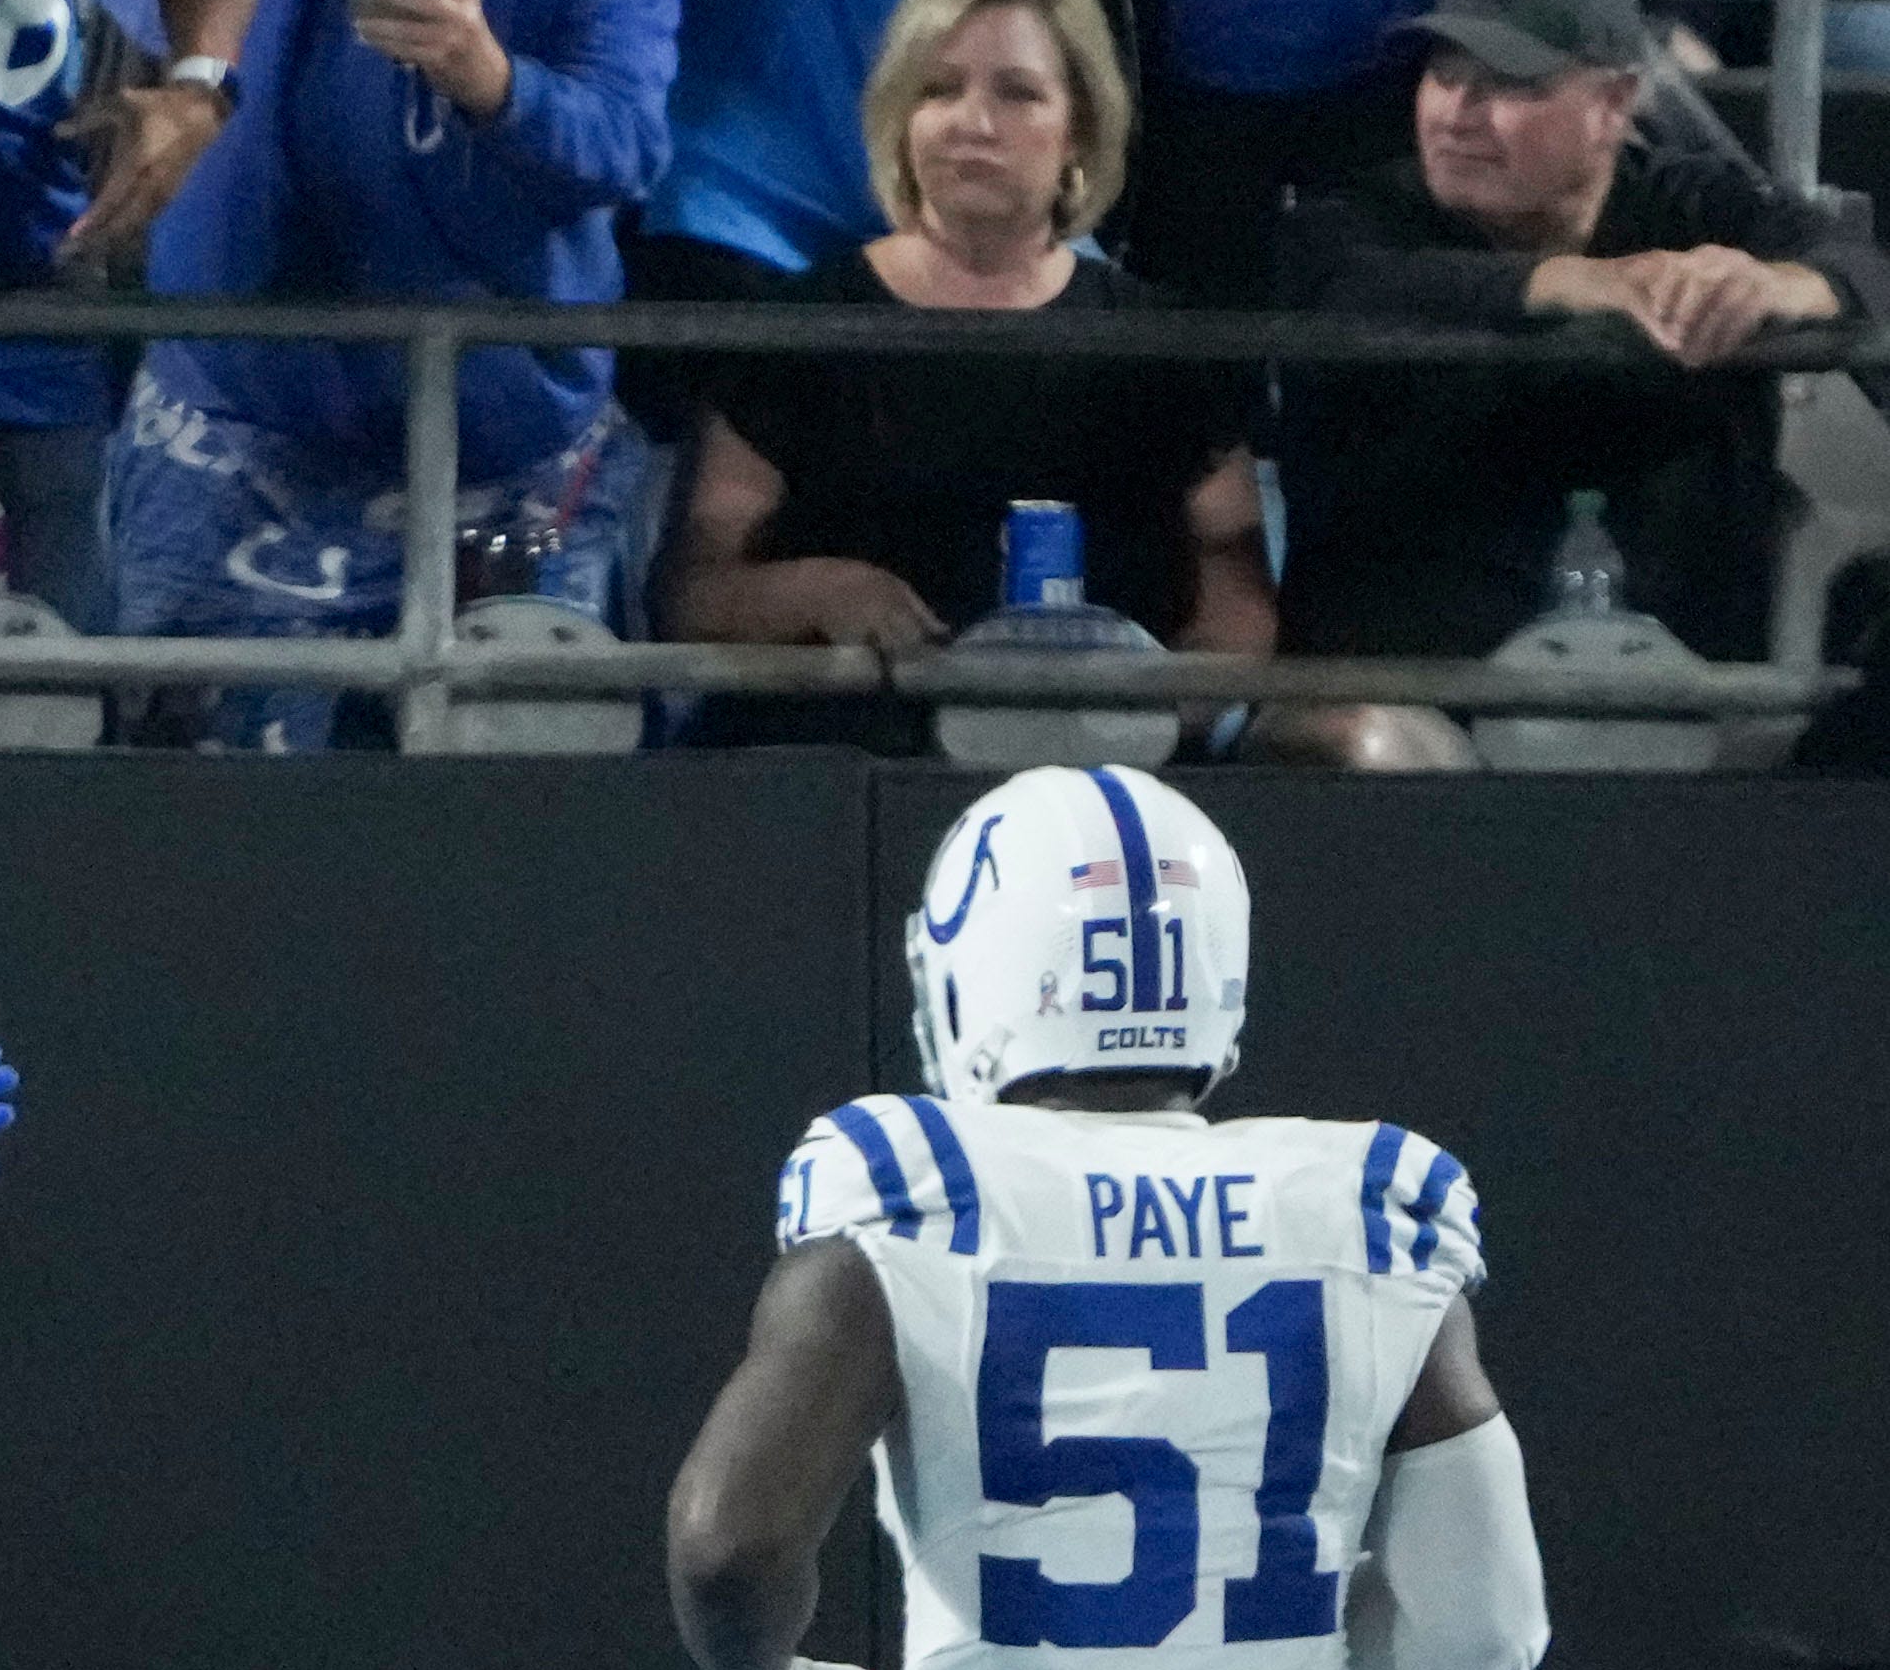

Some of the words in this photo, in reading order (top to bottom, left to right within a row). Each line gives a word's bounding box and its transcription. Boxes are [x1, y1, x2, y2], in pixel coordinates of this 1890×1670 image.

[1080, 917, 1189, 1013] 51
[1096, 1025, 1187, 1052] COLTS
[1084, 1172, 1265, 1260] PAYE
[976, 1278, 1340, 1650] 51
